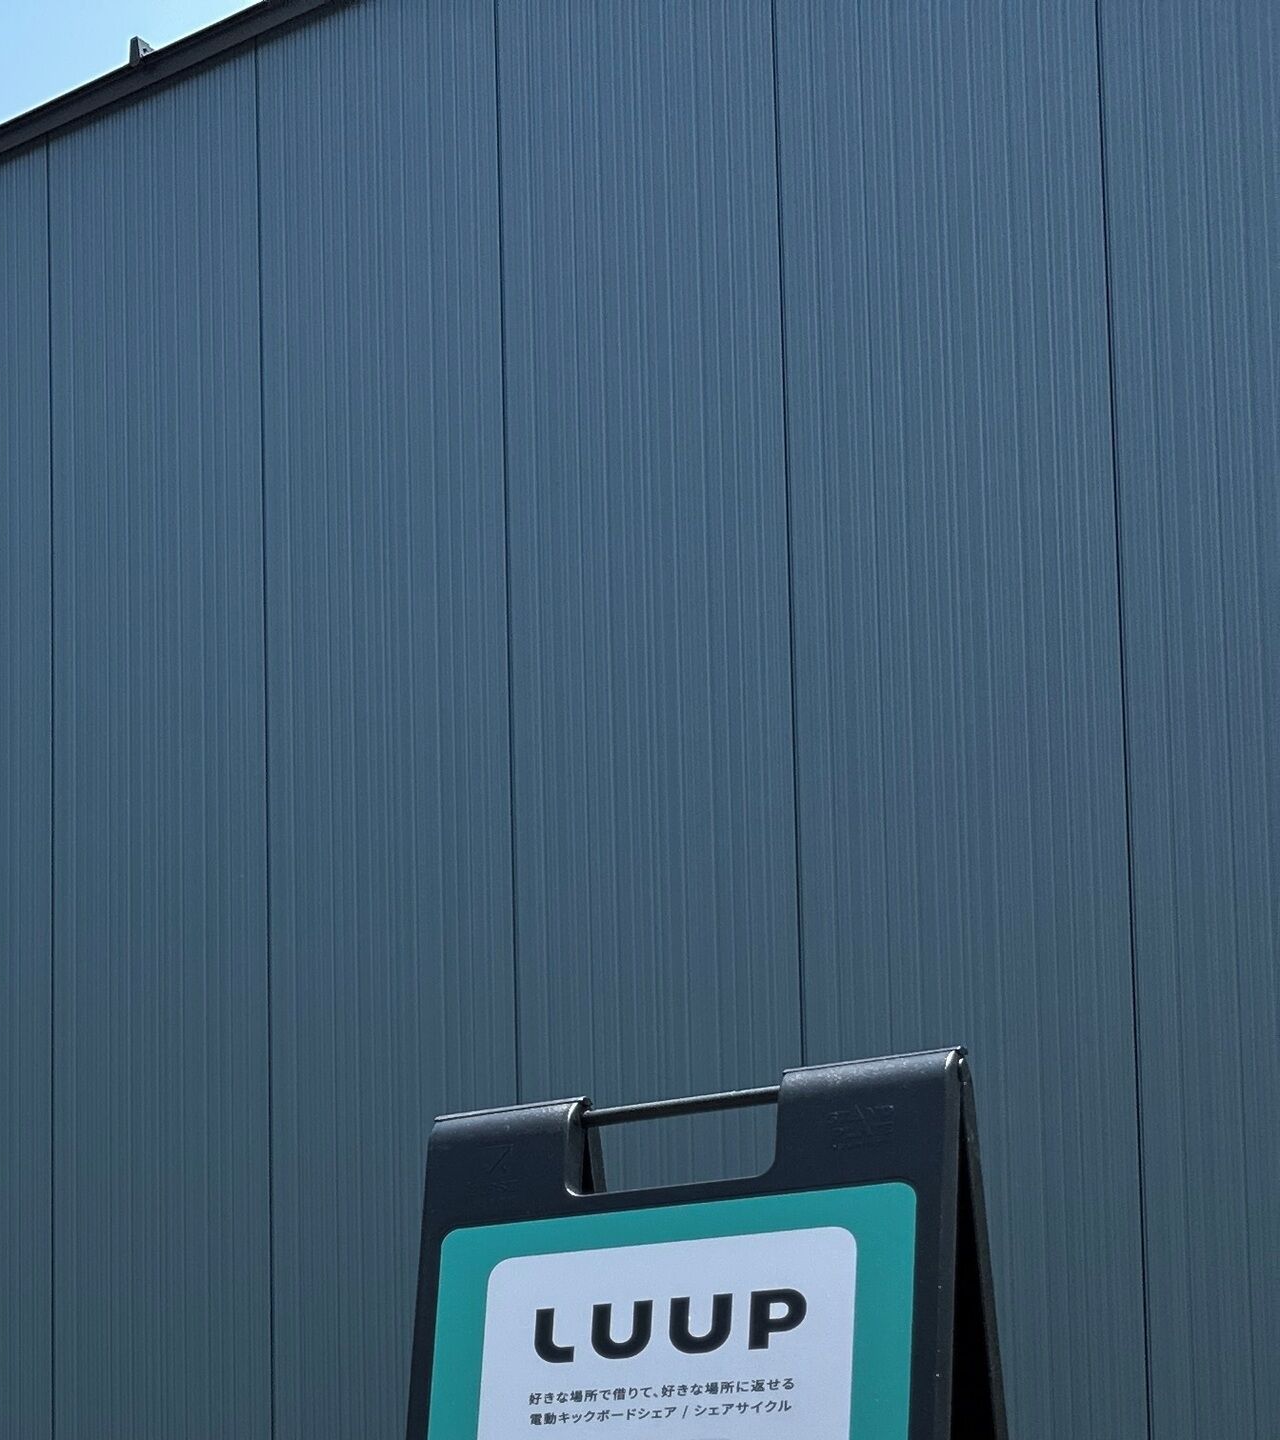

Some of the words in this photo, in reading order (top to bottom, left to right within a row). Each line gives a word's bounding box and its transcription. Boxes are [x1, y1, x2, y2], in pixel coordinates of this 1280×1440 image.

[534, 1288, 807, 1364] LUUP
[528, 1377, 795, 1406] 好きな場所で借りて、好きな場所に返せる
[529, 1405, 677, 1425] 電動キックボードシェア
[694, 1400, 792, 1417] シェアサイクル
